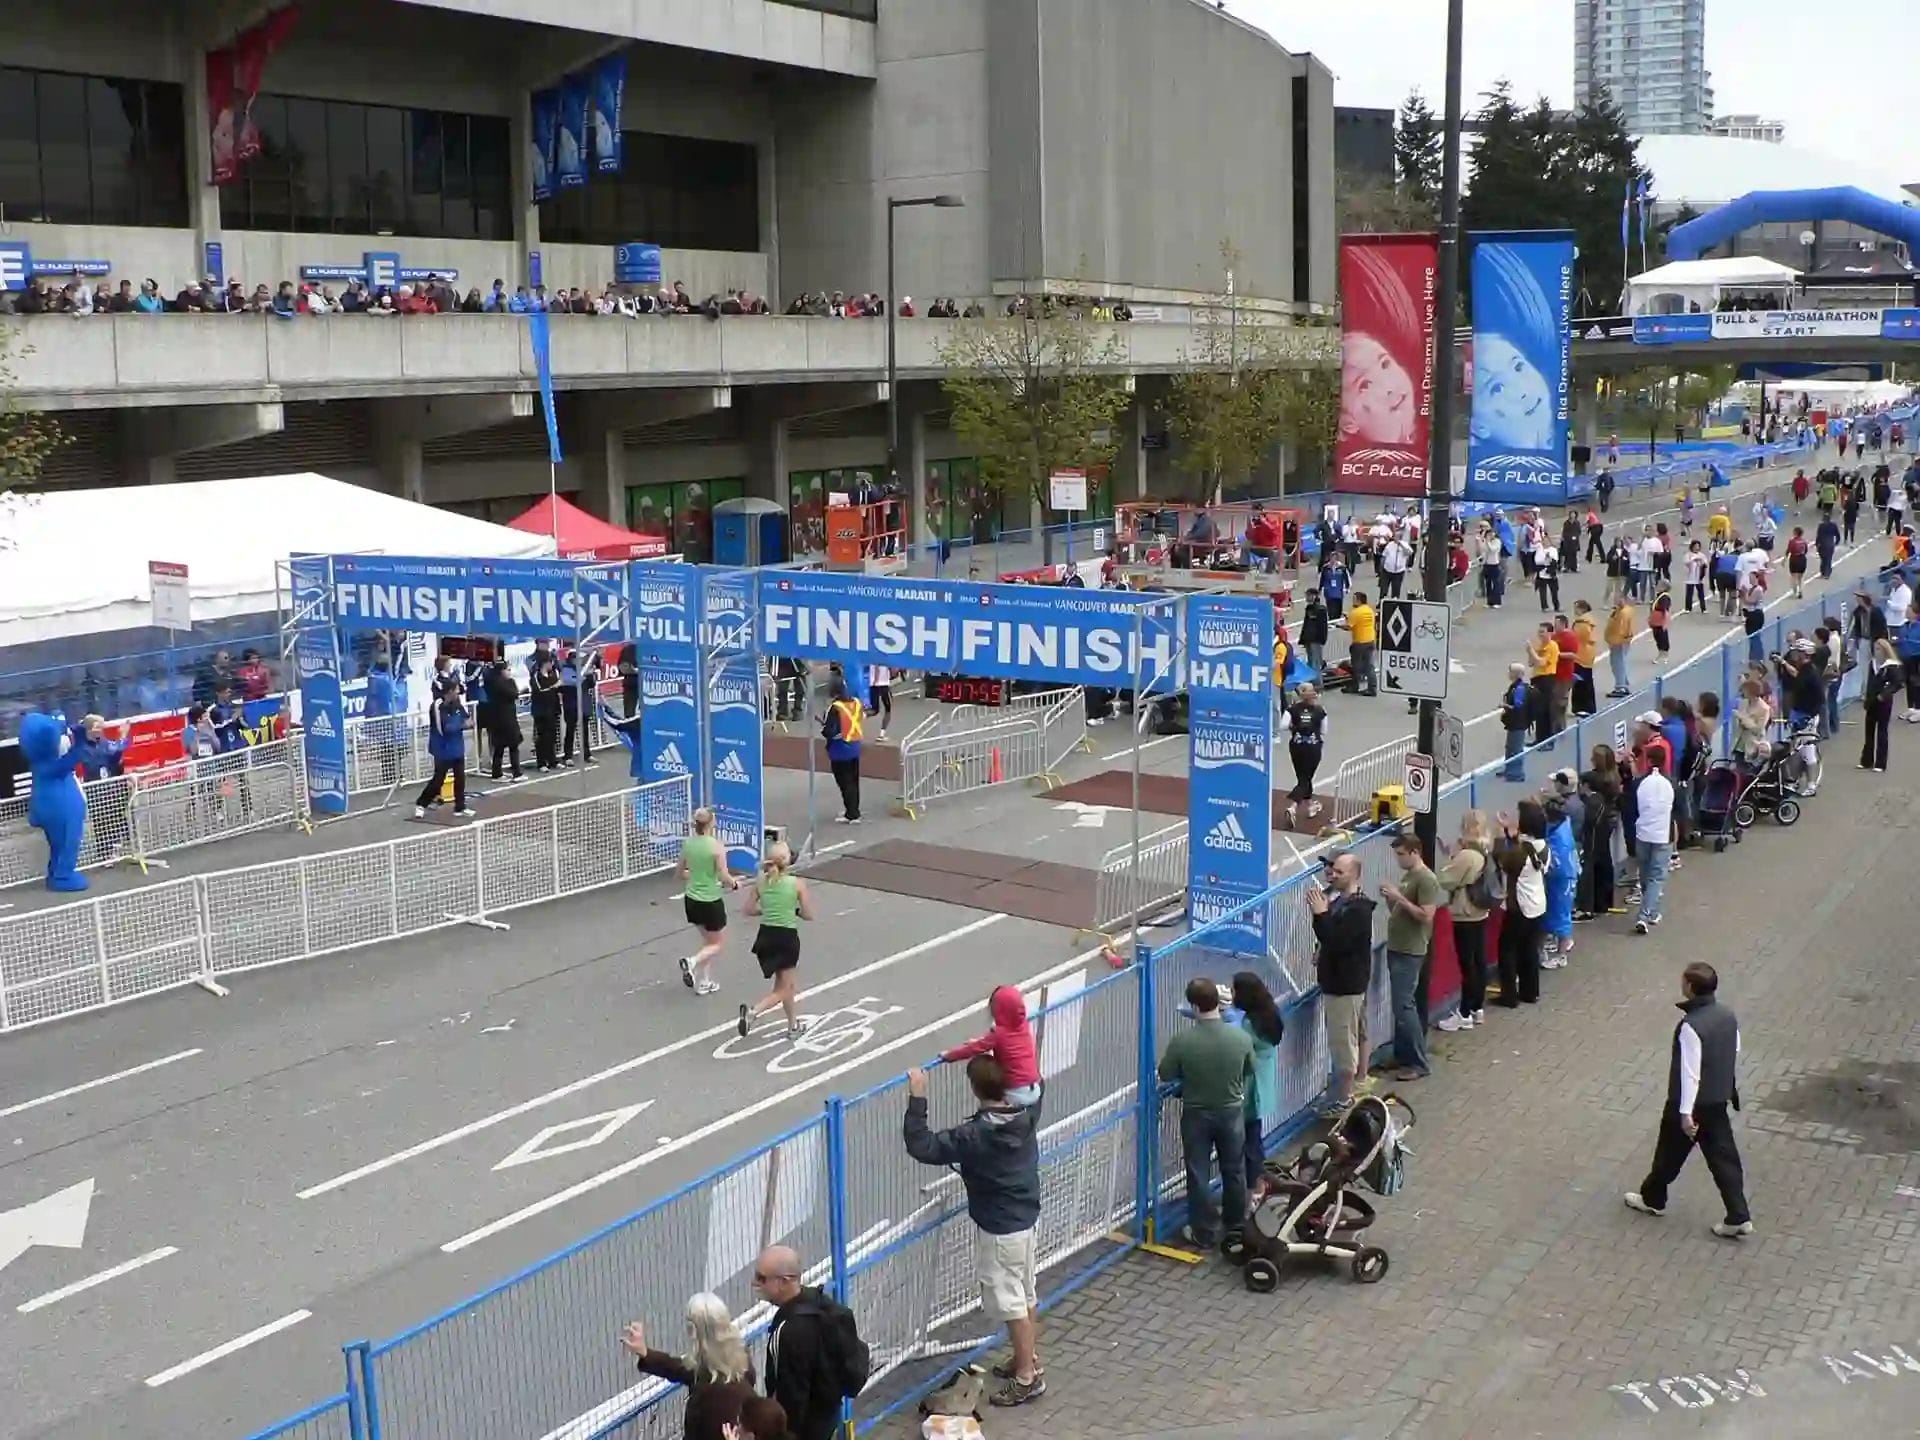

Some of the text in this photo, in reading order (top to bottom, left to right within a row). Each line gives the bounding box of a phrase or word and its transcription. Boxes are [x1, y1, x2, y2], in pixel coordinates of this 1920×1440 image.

[374, 260, 396, 286] E
[1423, 267, 1434, 298] Here
[1559, 265, 1570, 300] Here
[1423, 302, 1433, 334] Live
[1559, 304, 1569, 336] Live
[1716, 314, 1745, 324] FULL
[1749, 314, 1758, 323] &
[1762, 327, 1817, 336] START
[1421, 339, 1434, 393] Dreams
[1558, 342, 1568, 393] Dreams
[1341, 463, 1424, 479] BC PLACE
[1474, 469, 1562, 485] BC PLACE
[426, 565, 466, 577] MARATHN
[336, 583, 466, 624] FINISH
[640, 590, 685, 604] MARATHN
[894, 587, 953, 603] MARATHN
[473, 586, 620, 631] FINISH
[1055, 599, 1107, 613] VANCOUVER
[635, 616, 692, 642] FULL
[699, 622, 752, 650] HALF
[765, 604, 950, 659] FINISH
[1199, 619, 1260, 633] VANCOUVER
[962, 619, 1170, 677] FINISH
[1199, 630, 1260, 647] MARATHN
[1389, 654, 1440, 673] BEGINS
[1190, 660, 1268, 692] HALF
[643, 680, 693, 697] MARATHN
[1194, 727, 1264, 745] VANCOUVER
[1194, 738, 1264, 761] MARATHN
[653, 761, 689, 775] adidas
[714, 770, 751, 784] adidas
[1204, 835, 1252, 853] adidas
[1607, 1368, 1767, 1413] TOW
